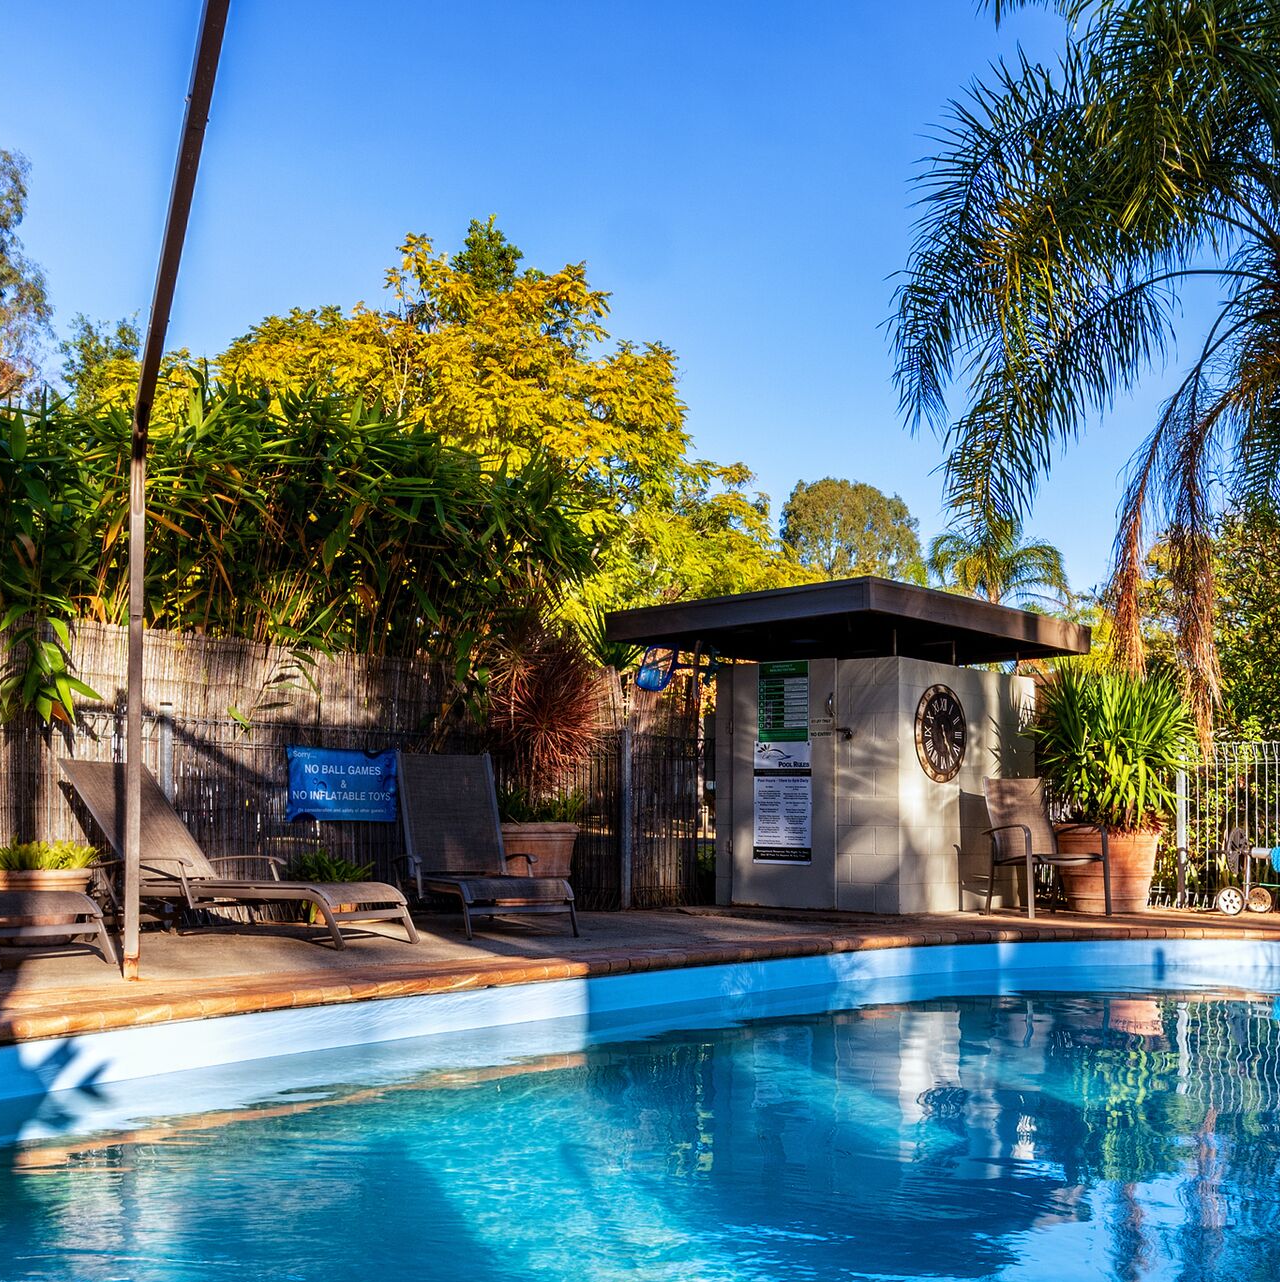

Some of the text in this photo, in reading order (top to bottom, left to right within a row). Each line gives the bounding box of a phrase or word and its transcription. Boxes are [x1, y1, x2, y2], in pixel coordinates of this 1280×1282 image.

[926, 711, 934, 724] X
[952, 716, 960, 725] II
[924, 726, 932, 737] IX
[304, 764, 381, 776] NO BALL GAMES
[340, 780, 347, 788] &
[292, 790, 391, 801] NO INFLATABLE TOYS
